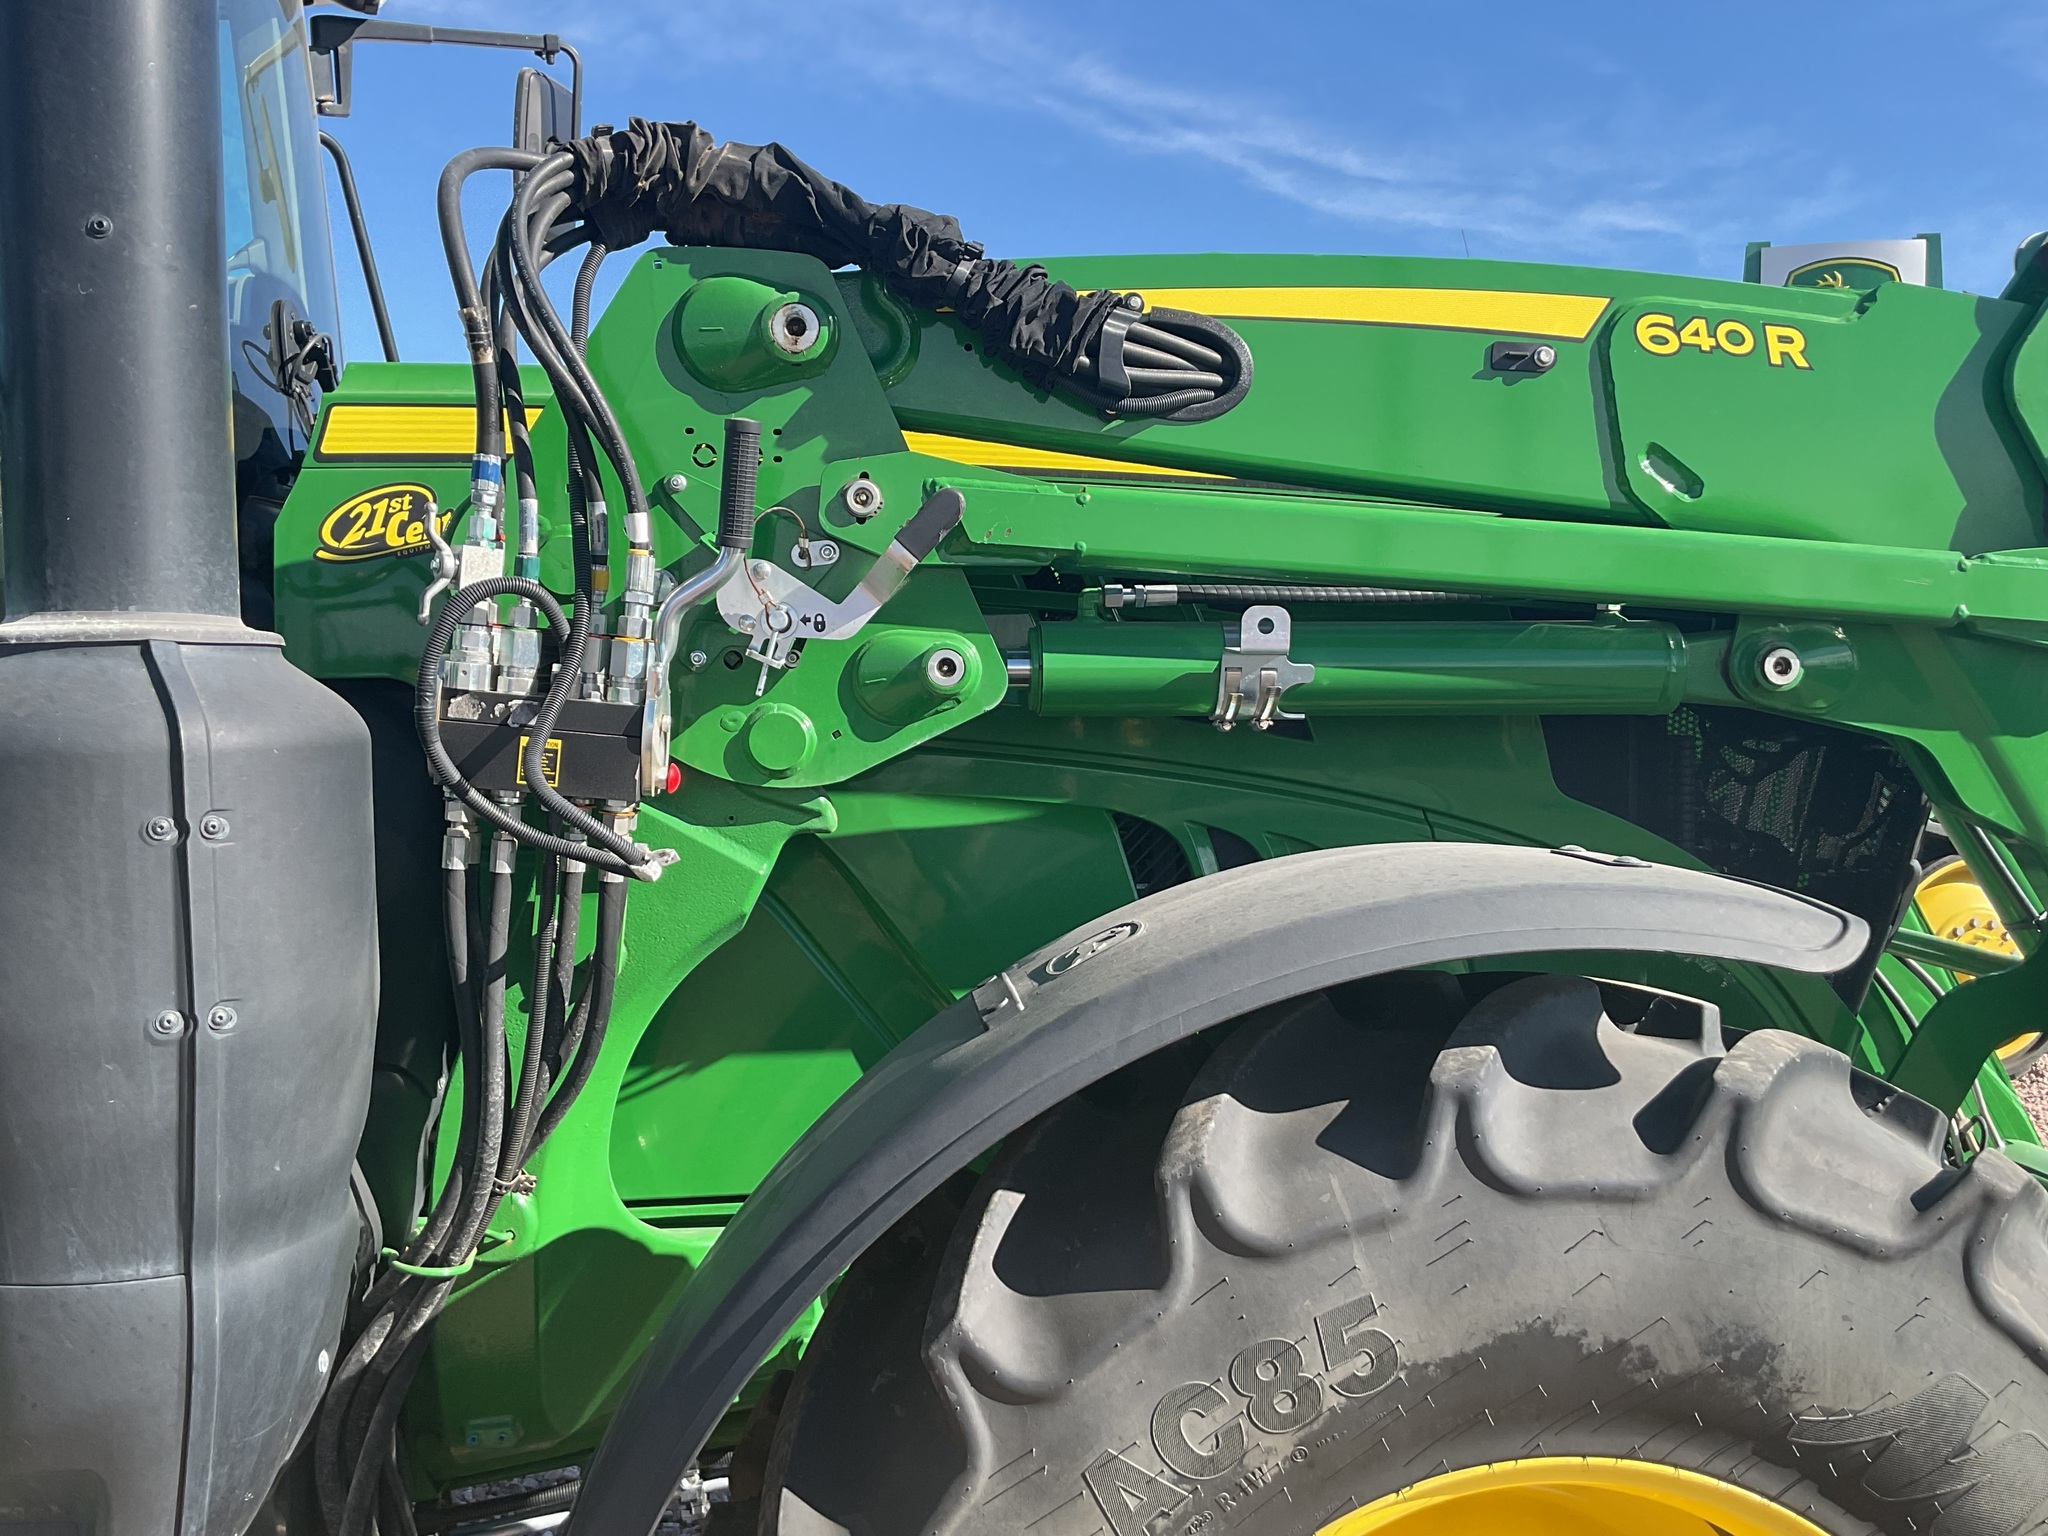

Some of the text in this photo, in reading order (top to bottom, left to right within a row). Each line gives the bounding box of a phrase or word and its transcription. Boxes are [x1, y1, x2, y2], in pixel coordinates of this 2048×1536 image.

[1633, 312, 1815, 371] 640 R
[581, 379, 591, 390] EN
[590, 393, 610, 426] exceeds
[339, 494, 413, 548] 21st
[397, 544, 431, 557] EQUIPM
[1214, 1463, 1272, 1513] R-1W
